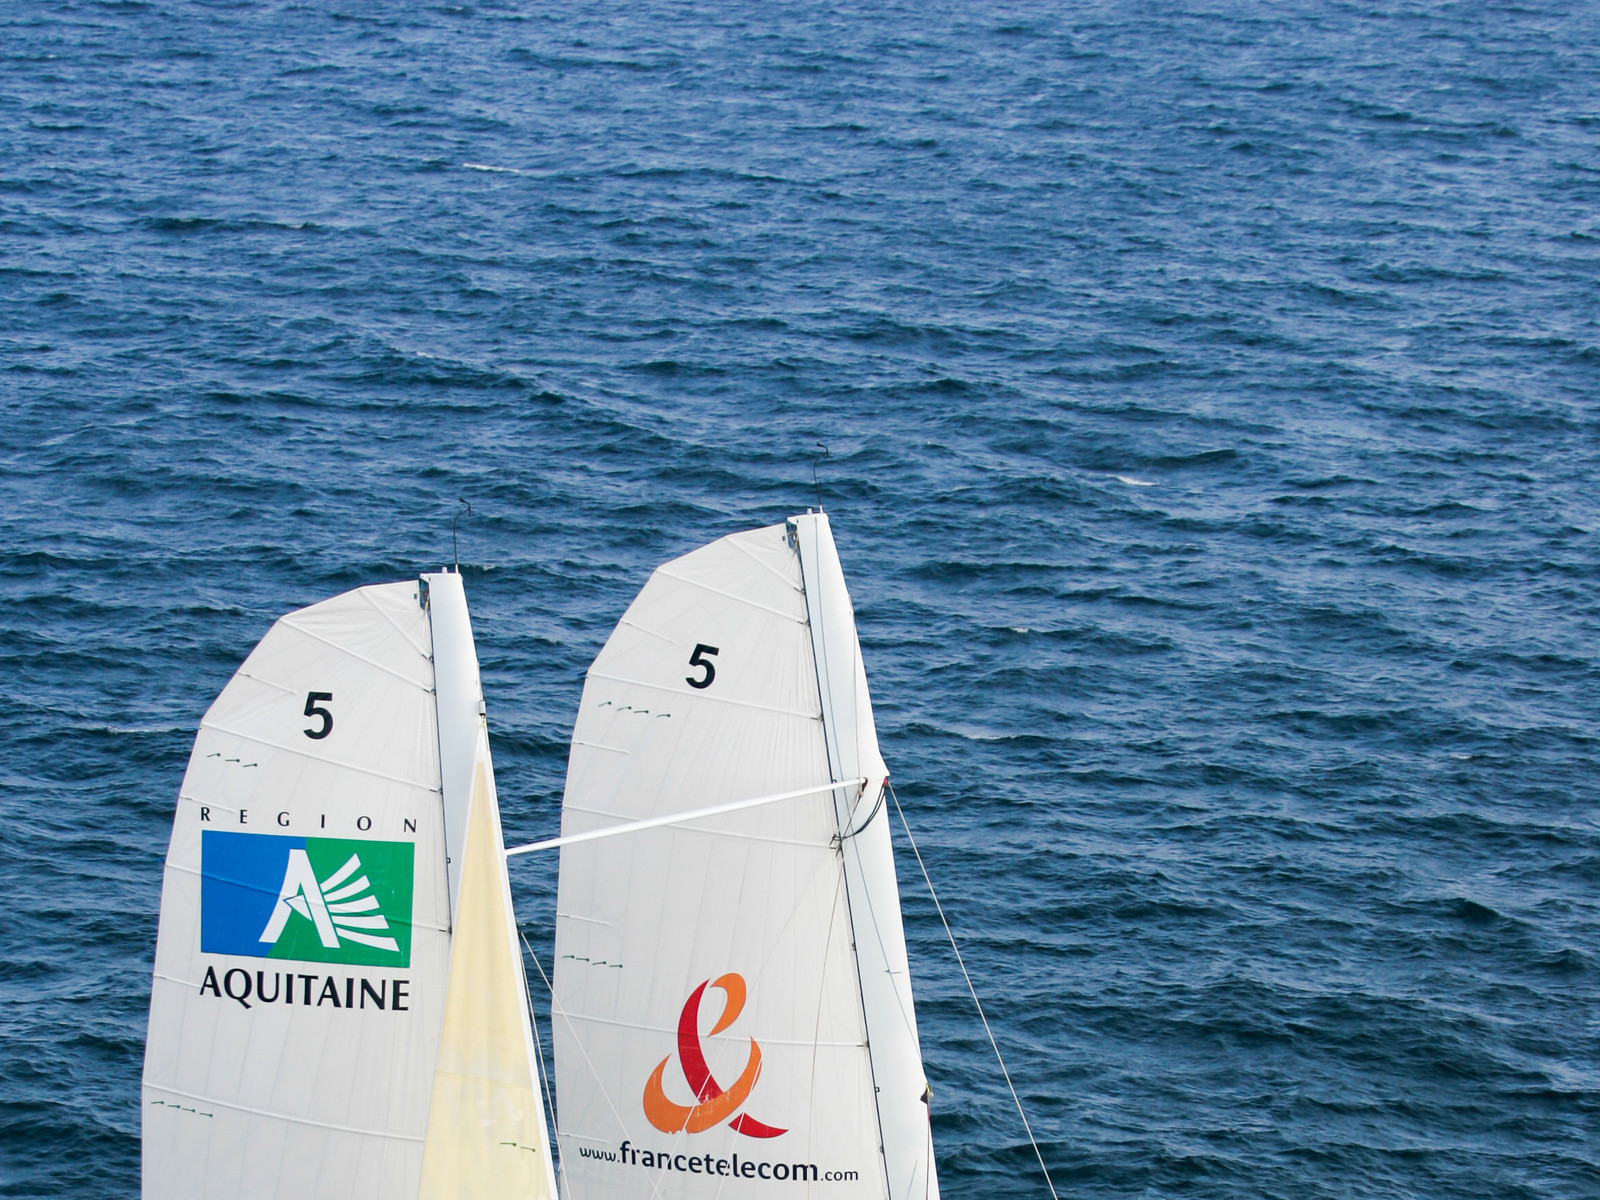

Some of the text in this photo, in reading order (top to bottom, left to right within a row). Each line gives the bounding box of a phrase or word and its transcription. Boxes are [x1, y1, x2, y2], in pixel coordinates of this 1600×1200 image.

[685, 643, 719, 689] 5
[303, 691, 333, 739] 5
[201, 807, 417, 833] REGION
[200, 966, 410, 1010] AQUITAINE
[579, 1141, 859, 1181] www.francetelecom.com
